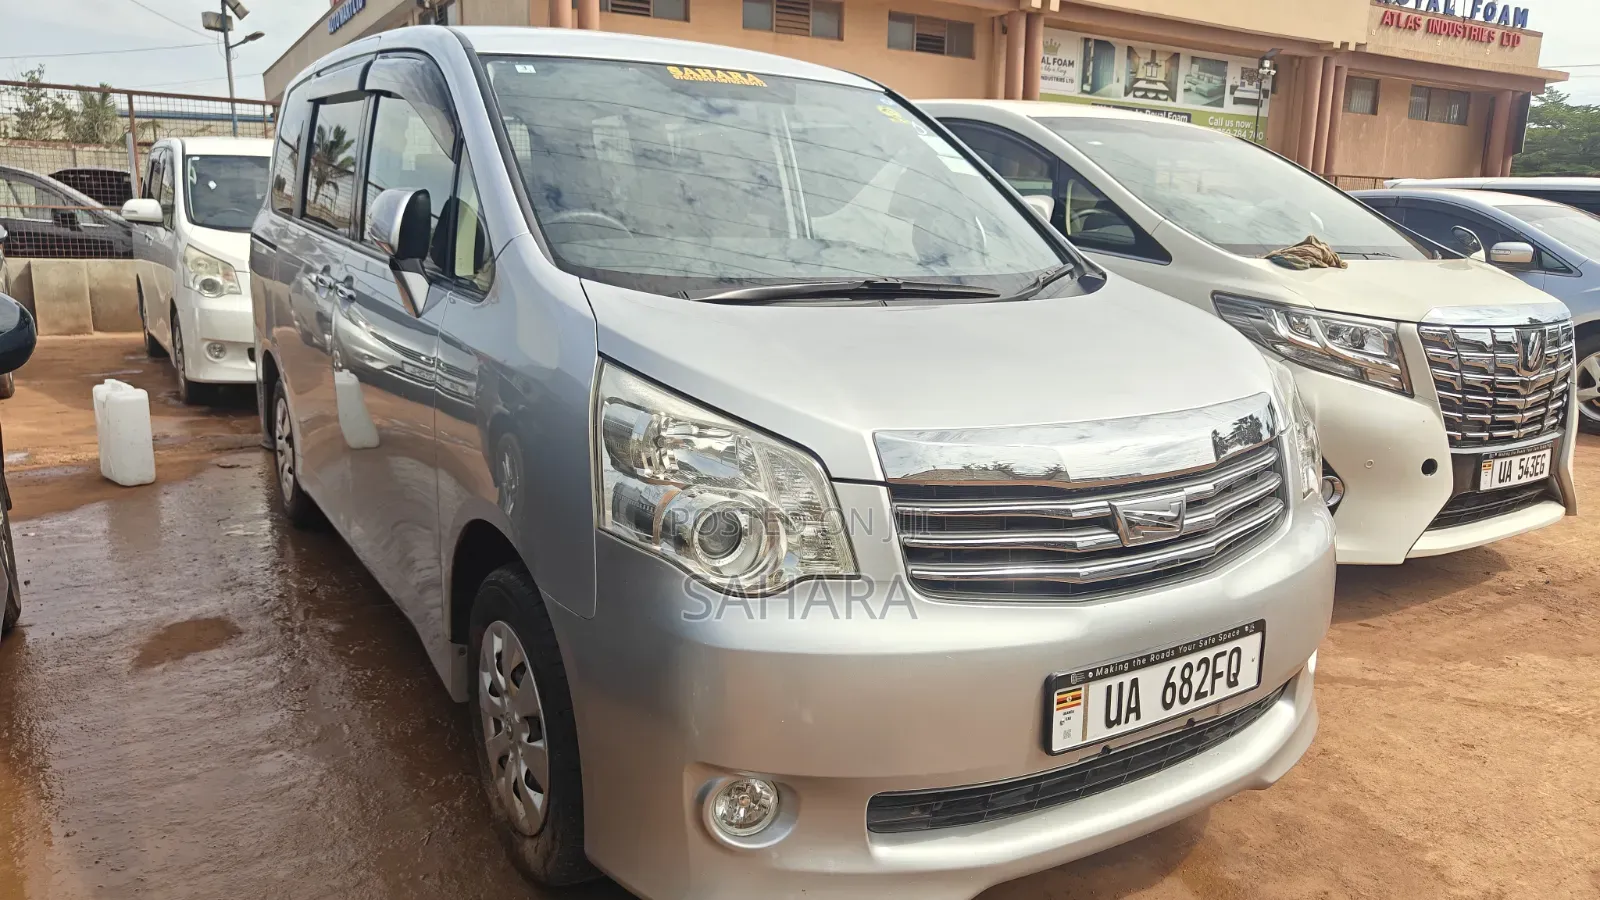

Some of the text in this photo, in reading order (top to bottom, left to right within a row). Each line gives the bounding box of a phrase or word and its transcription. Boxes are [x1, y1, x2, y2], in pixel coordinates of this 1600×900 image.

[1470, 0, 1529, 28] FOAM
[1381, 10, 1521, 47] ATLAS INDUSTRIES LTD
[1052, 57, 1075, 68] FOAM
[666, 66, 765, 85] SAHARA
[1041, 75, 1065, 83] NDUSTRIES
[1208, 116, 1253, 129] Call us now:
[1498, 460, 1513, 484] UA
[1095, 661, 1129, 678] Making
[1132, 657, 1147, 670] the
[1149, 648, 1176, 663] Roads
[1178, 642, 1197, 655] Your
[1199, 635, 1216, 648] Safe
[1218, 628, 1241, 644] Space
[1105, 646, 1243, 729] UA 682FQ
